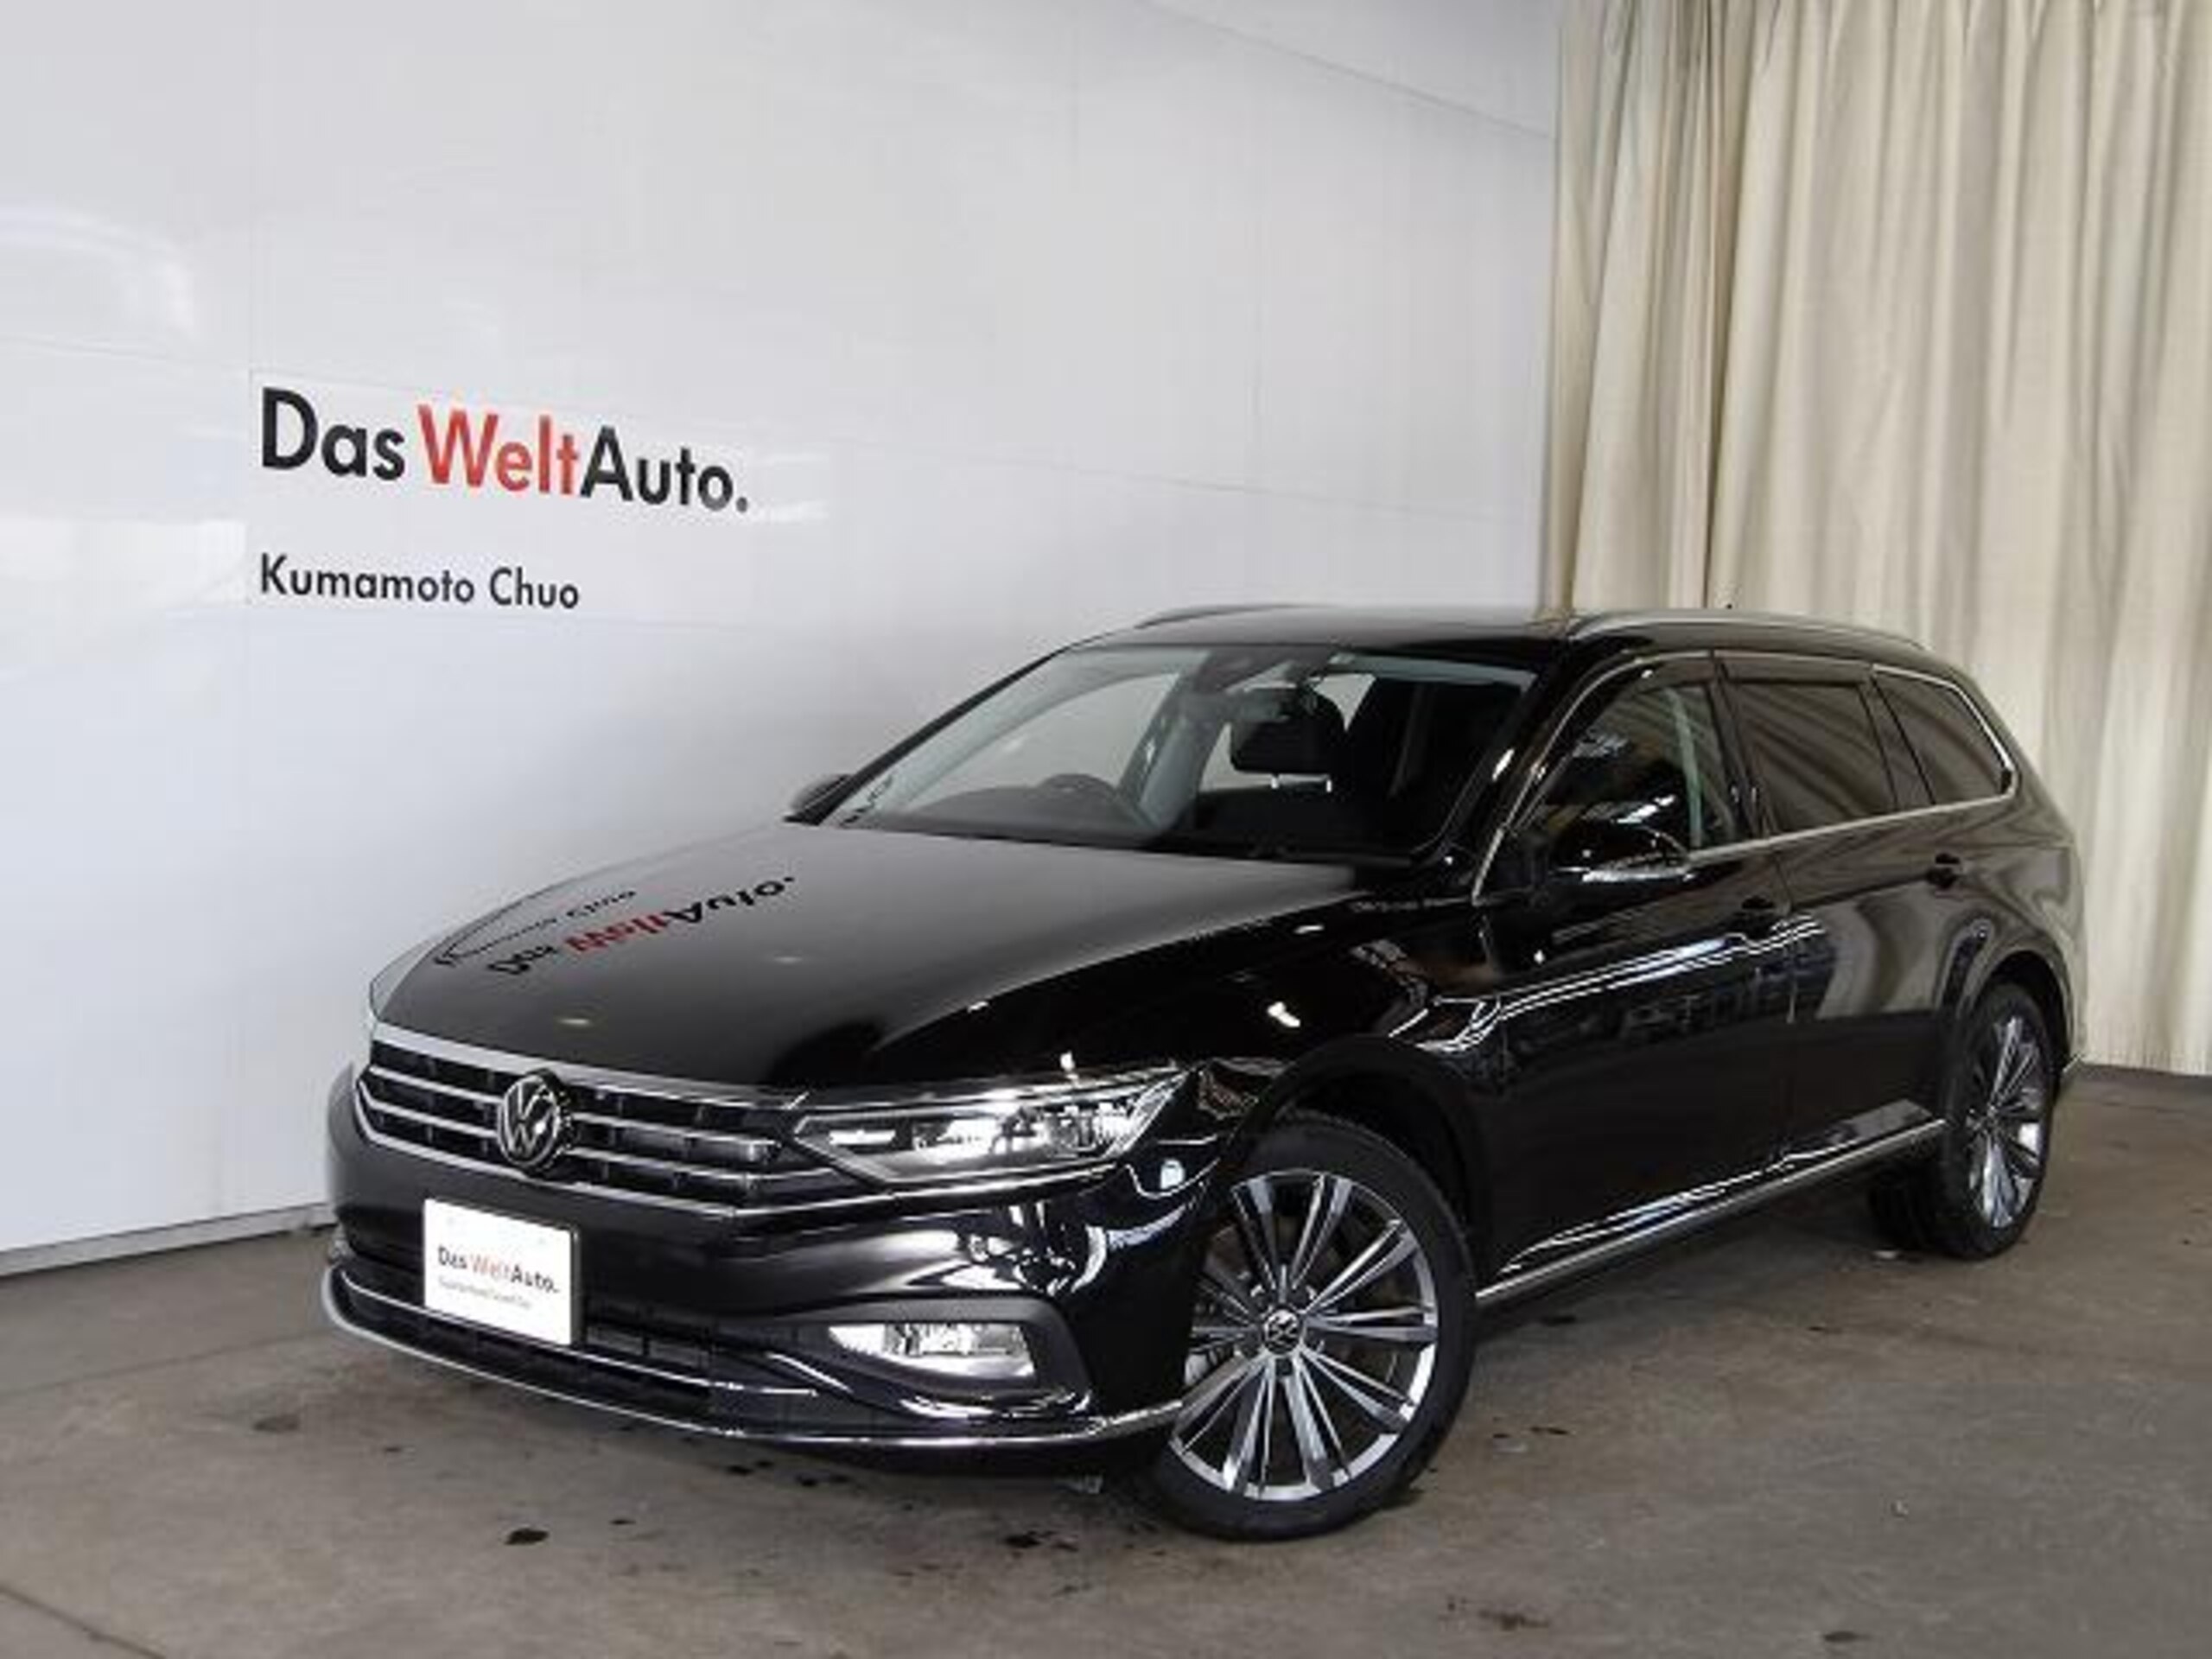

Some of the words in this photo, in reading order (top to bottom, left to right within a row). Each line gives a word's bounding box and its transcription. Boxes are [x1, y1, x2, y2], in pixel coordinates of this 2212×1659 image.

[262, 387, 406, 481] Das
[260, 553, 475, 605] Kumamoto
[489, 566, 580, 609] Chuo
